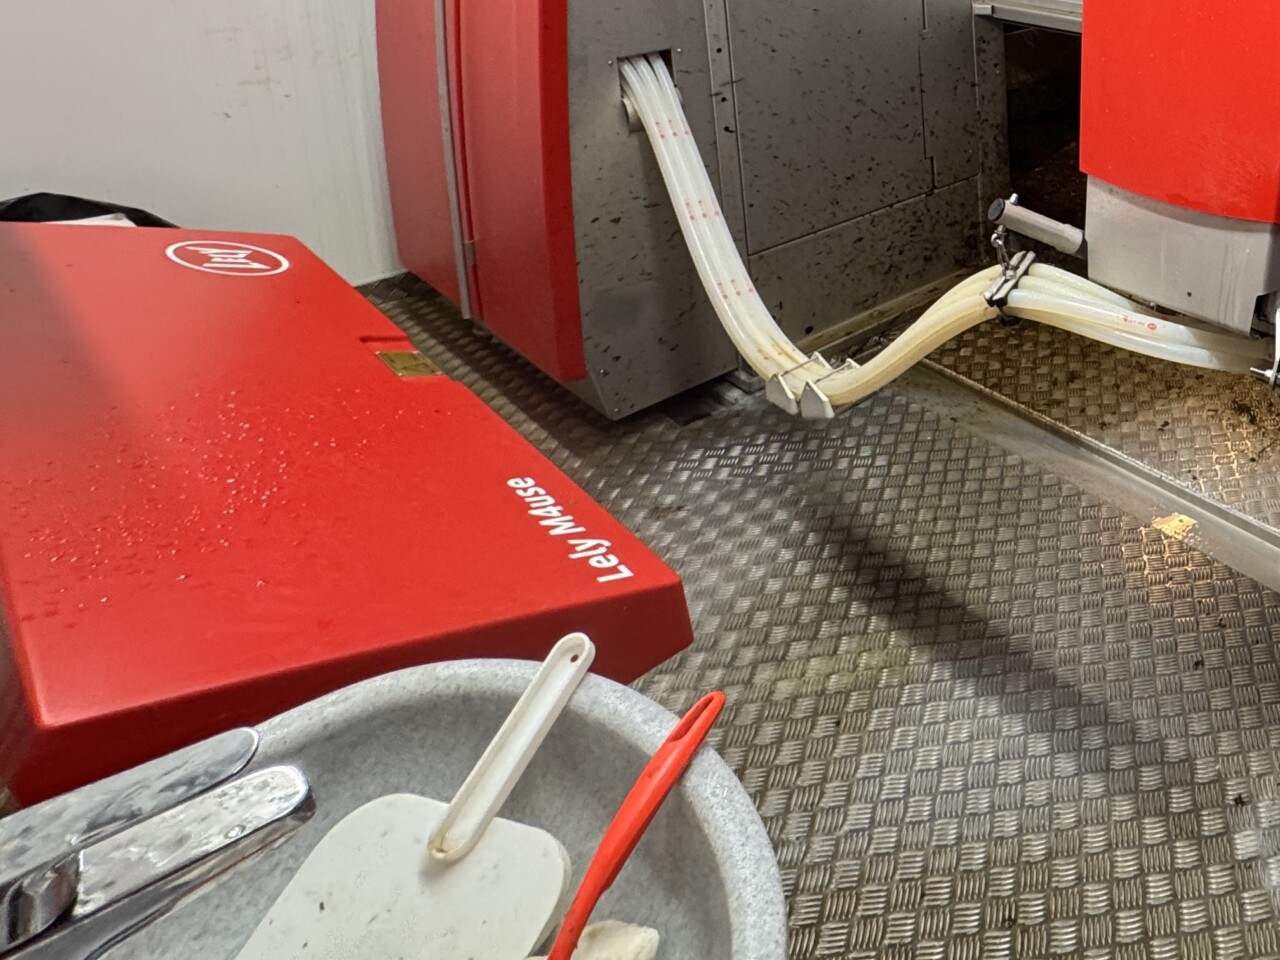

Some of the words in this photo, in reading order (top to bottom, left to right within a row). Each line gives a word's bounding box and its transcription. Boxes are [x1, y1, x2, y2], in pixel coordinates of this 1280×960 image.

[184, 246, 272, 270] LELY
[506, 476, 586, 536] M4use
[567, 538, 635, 583] Lely
